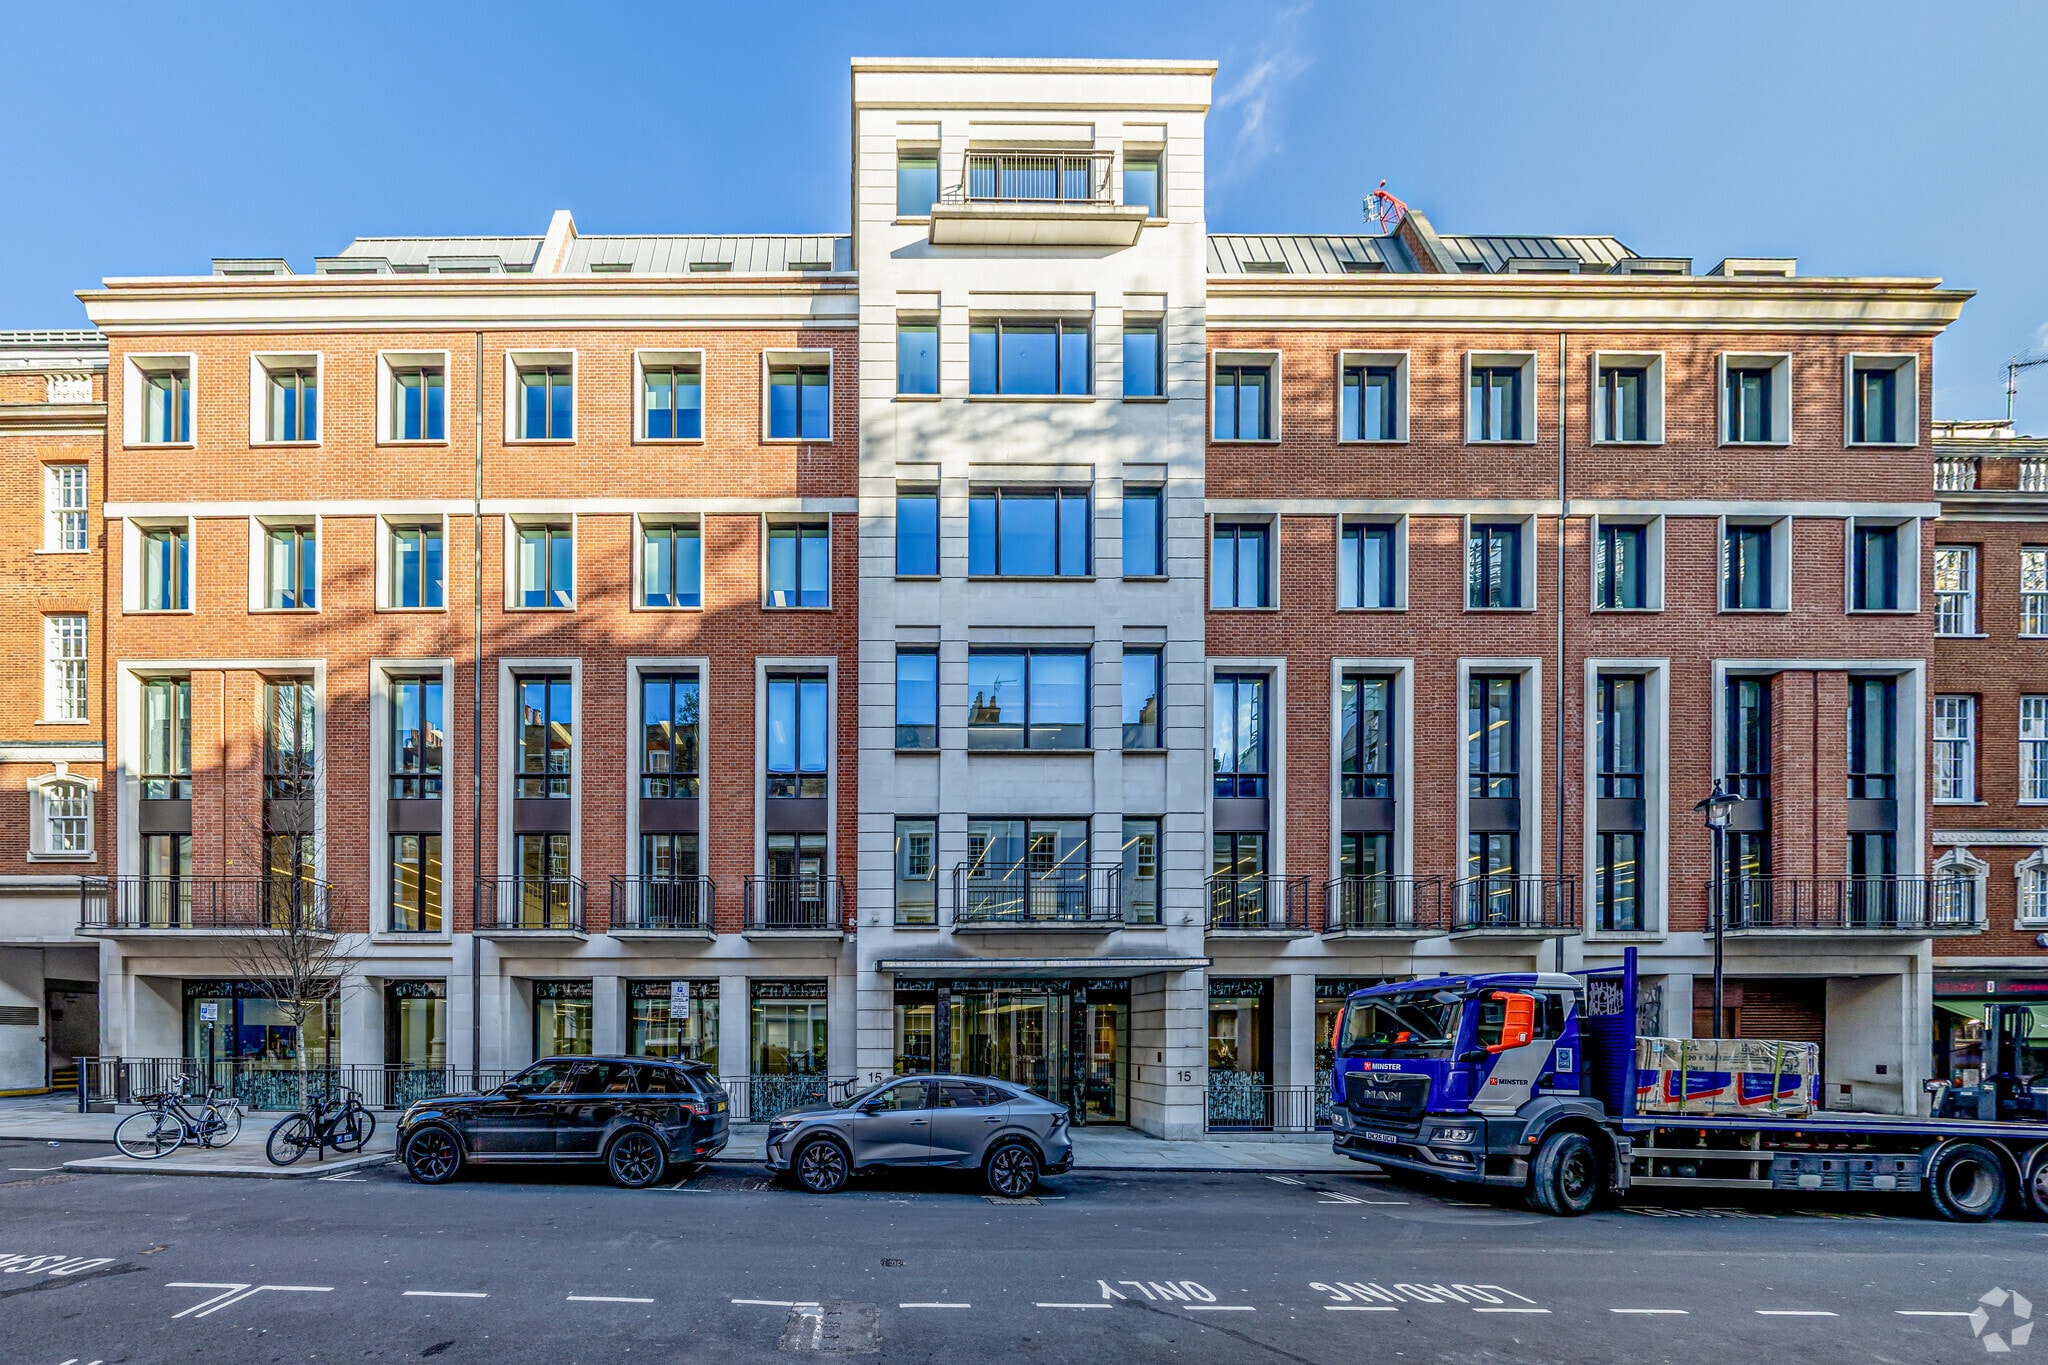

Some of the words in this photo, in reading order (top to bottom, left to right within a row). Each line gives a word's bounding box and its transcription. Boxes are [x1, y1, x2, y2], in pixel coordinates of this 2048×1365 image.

[868, 1072, 882, 1083] 15
[1177, 1071, 1191, 1082] 15
[1364, 1089, 1402, 1101] MAN
[1096, 1279, 1218, 1302] ONLY
[1309, 1281, 1540, 1304] LOADING
